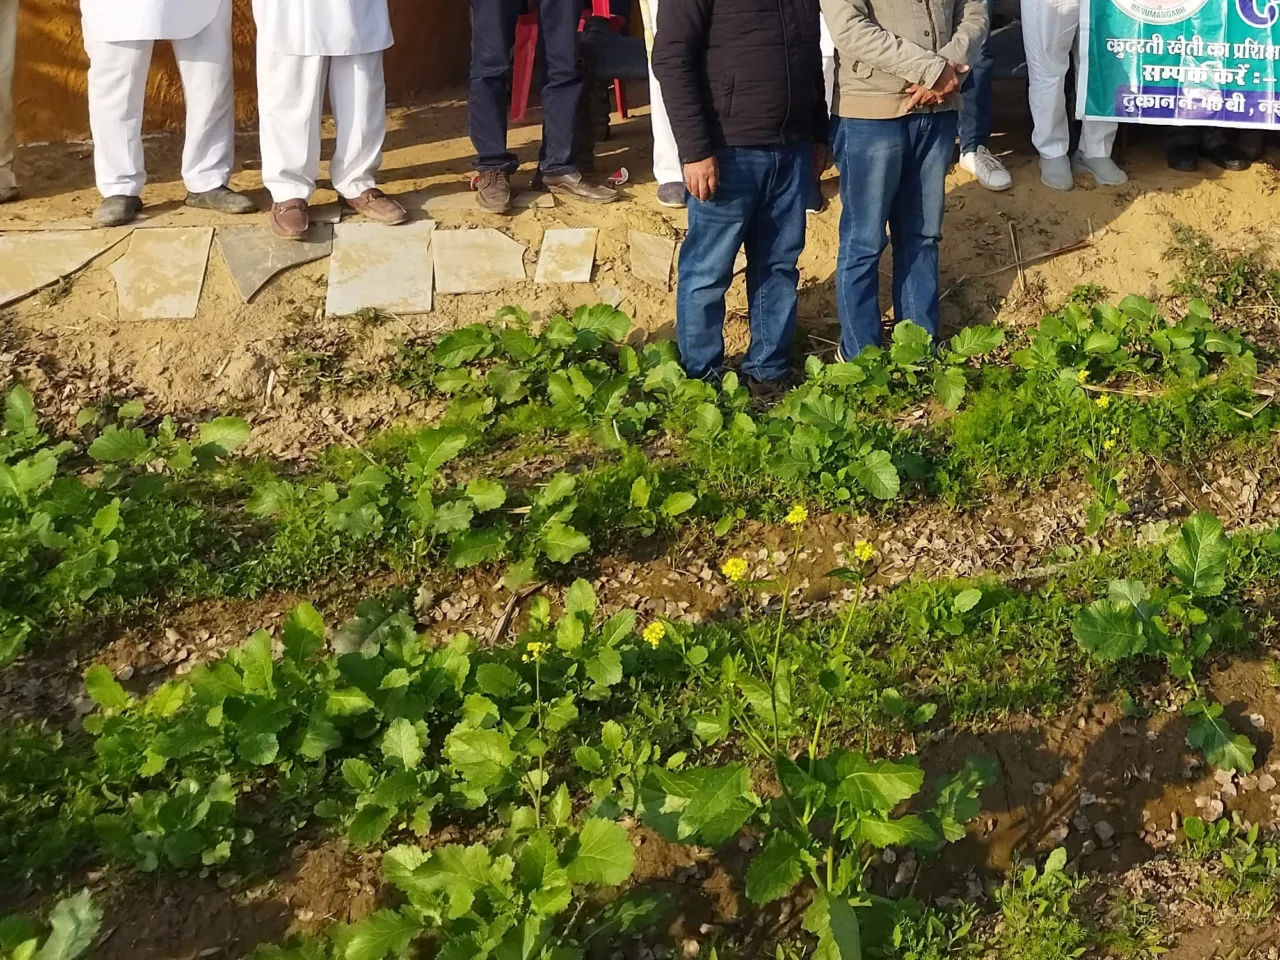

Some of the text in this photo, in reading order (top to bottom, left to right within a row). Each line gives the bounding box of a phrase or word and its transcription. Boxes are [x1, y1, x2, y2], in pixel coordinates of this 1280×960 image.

[1105, 35, 1164, 59] कुदरती
[1167, 36, 1203, 57] खेती
[1206, 42, 1230, 58] का
[1213, 64, 1250, 85] करें
[1122, 93, 1176, 112] दुकान
